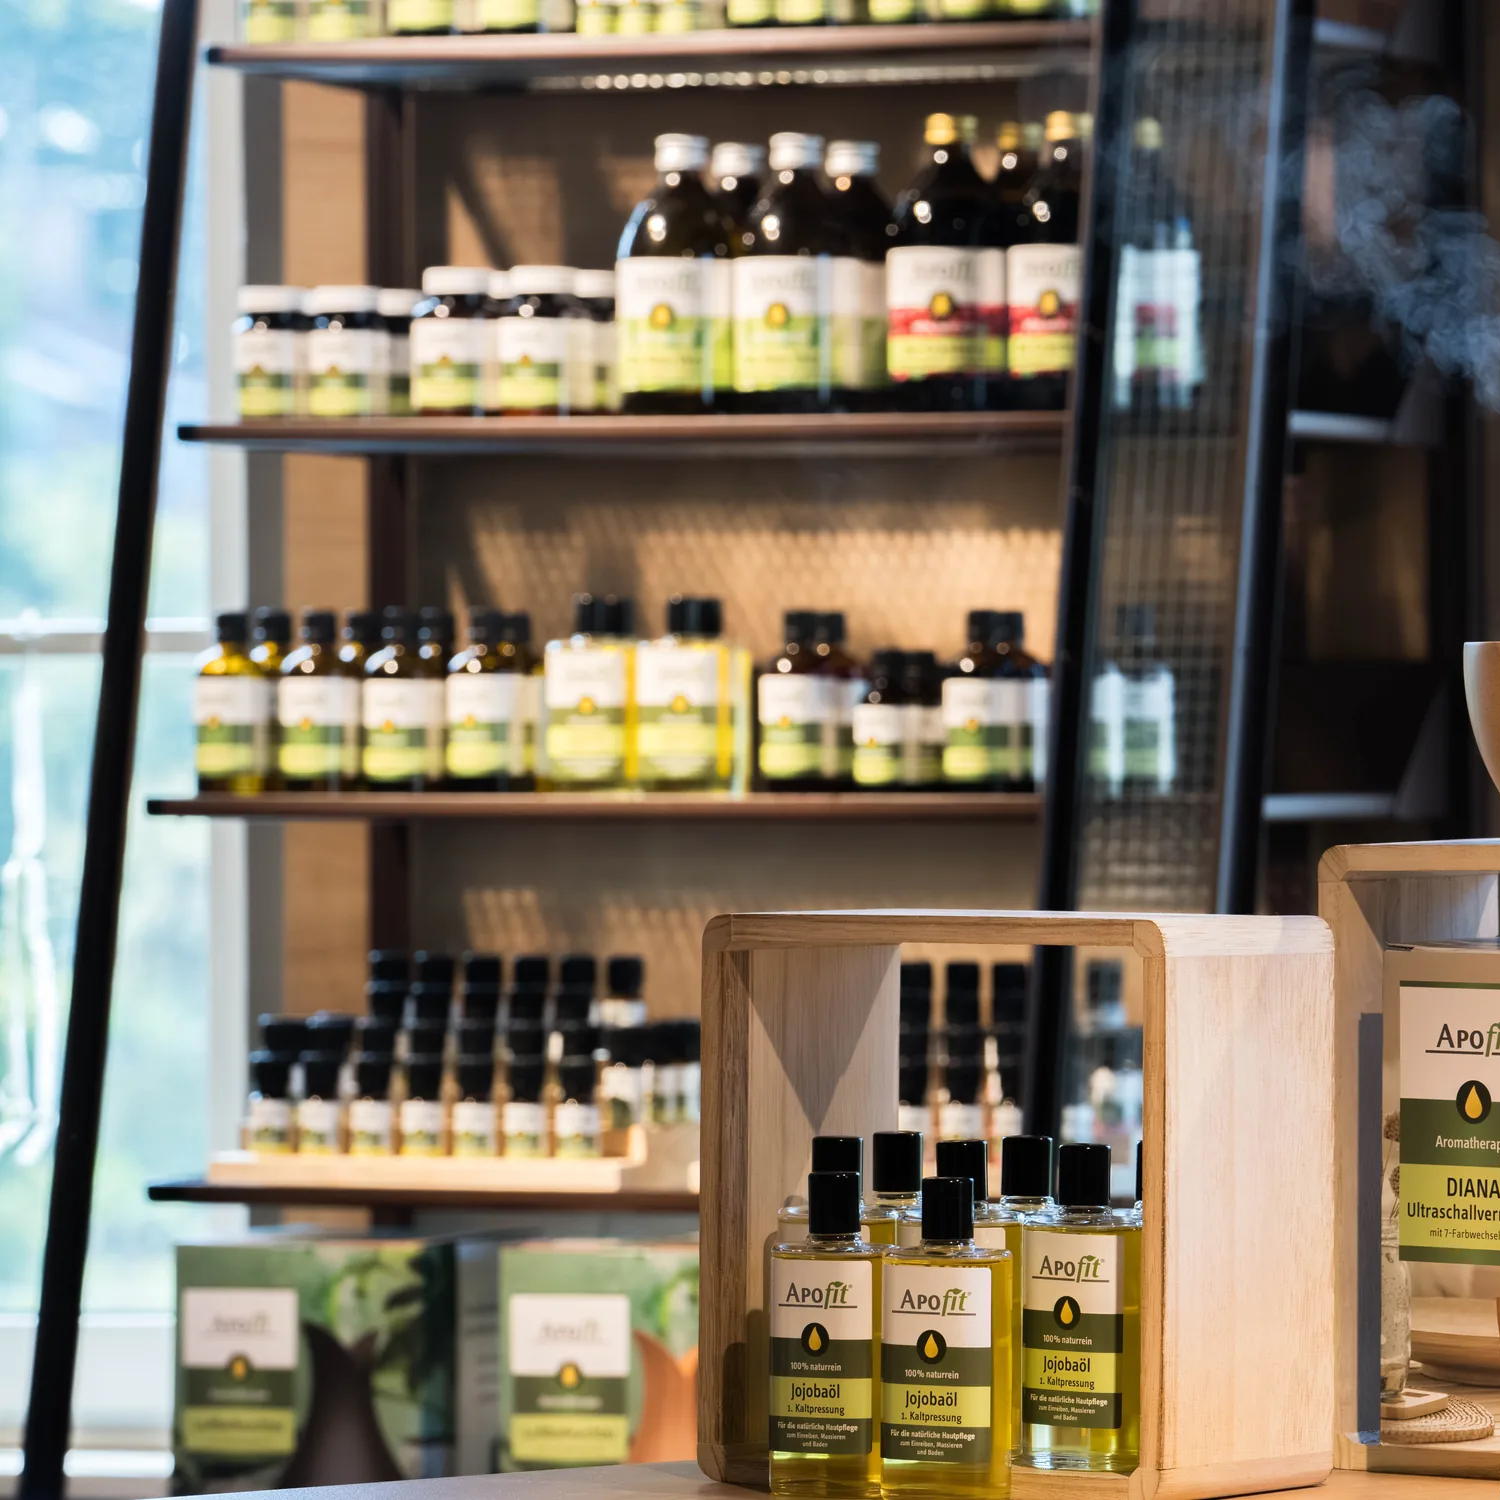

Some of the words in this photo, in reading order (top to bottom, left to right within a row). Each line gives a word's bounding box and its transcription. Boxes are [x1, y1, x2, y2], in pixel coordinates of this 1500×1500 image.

[1447, 1177, 1500, 1199] DIANA
[1429, 1227, 1443, 1239] mit
[1444, 1228, 1500, 1241] 7-Farbwechsel
[1043, 1334, 1061, 1343] 100%
[1061, 1336, 1092, 1345] naturrein
[790, 1361, 809, 1371] 100%
[810, 1363, 842, 1372] naturrein
[1043, 1355, 1091, 1374] Jojobaöl
[904, 1369, 925, 1378] 100%
[926, 1370, 960, 1380] naturrein
[1039, 1377, 1045, 1385] 1.
[1047, 1376, 1095, 1390] Kaltpressung
[790, 1383, 840, 1401] Jojobaöl
[905, 1390, 958, 1409] Jojobaöl
[1030, 1393, 1038, 1401] Für
[1039, 1394, 1047, 1402] die
[1048, 1395, 1075, 1404] natürliche
[1076, 1397, 1108, 1407] Hautpflege
[787, 1405, 793, 1413] 1.
[795, 1403, 845, 1417] Kaltpressung
[1070, 1407, 1096, 1415] Massieren
[901, 1412, 908, 1420] 1.
[909, 1411, 962, 1424] Kaltpressung
[777, 1421, 786, 1429] Für
[796, 1422, 825, 1430] natürliche
[825, 1423, 858, 1433] Hautpflege
[900, 1429, 910, 1437] die
[911, 1430, 941, 1438] natürliche
[942, 1432, 976, 1441] Hautpflege
[936, 1441, 963, 1449] Massieren
